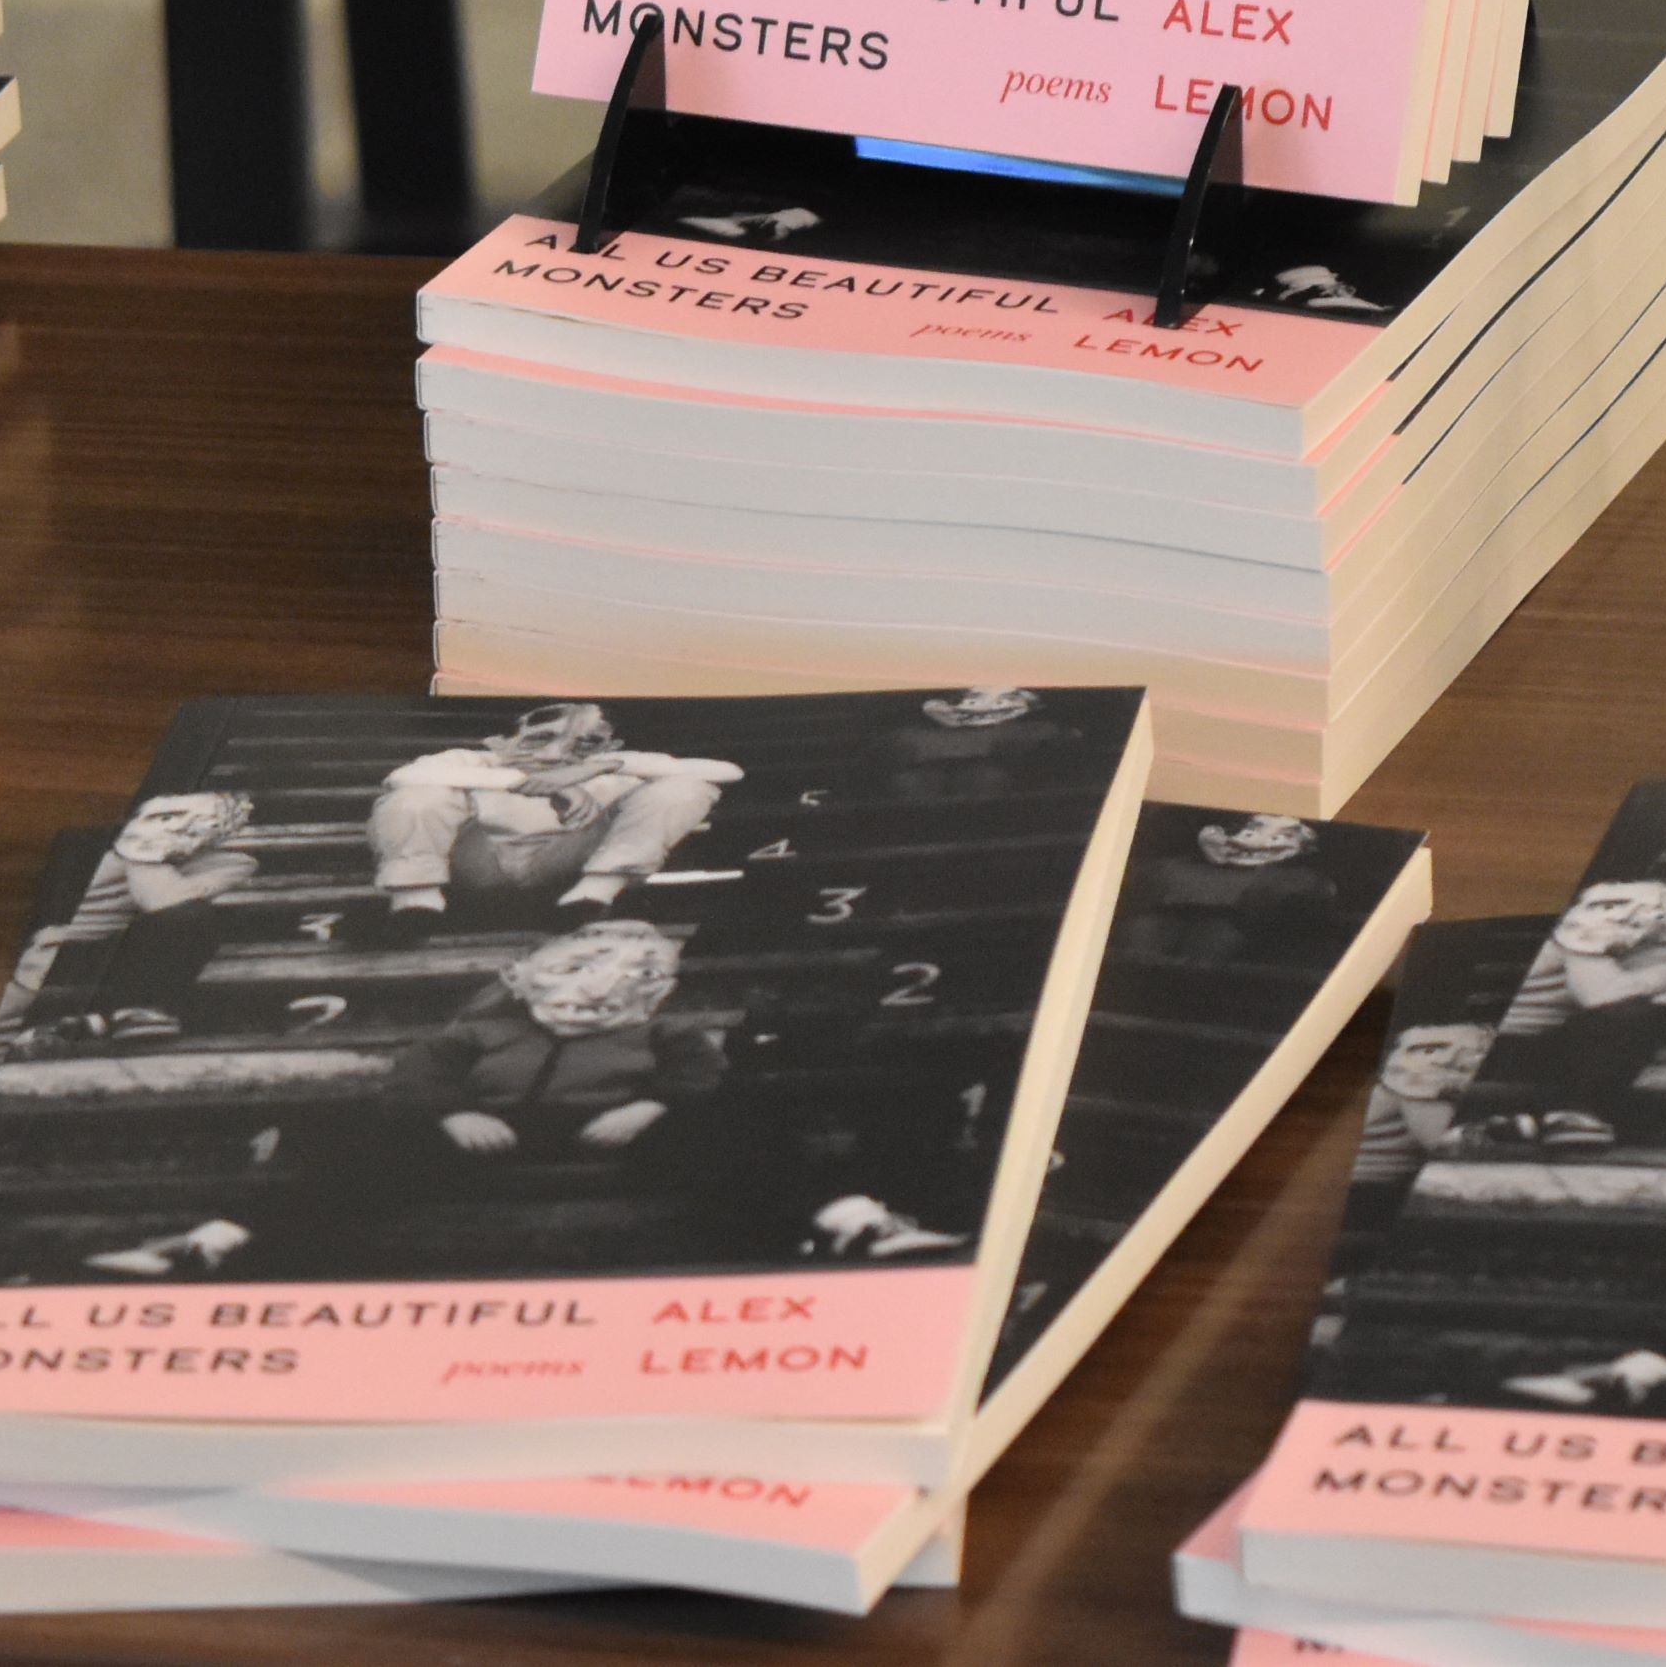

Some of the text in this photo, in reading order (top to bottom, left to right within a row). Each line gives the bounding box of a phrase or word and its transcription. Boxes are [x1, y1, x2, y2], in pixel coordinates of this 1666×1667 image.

[999, 70, 1110, 104] poems
[492, 259, 809, 320] MONSTERS
[525, 233, 1061, 316] AL US BEAUTIFUL
[1073, 334, 1264, 373] LEMON
[85, 1303, 177, 1328] US
[208, 1301, 598, 1328] BEAUTIFUL
[652, 1297, 818, 1324] ALEX
[639, 1346, 868, 1375] LEMON
[1331, 1424, 1470, 1452] ALL
[1501, 1431, 1600, 1461] US
